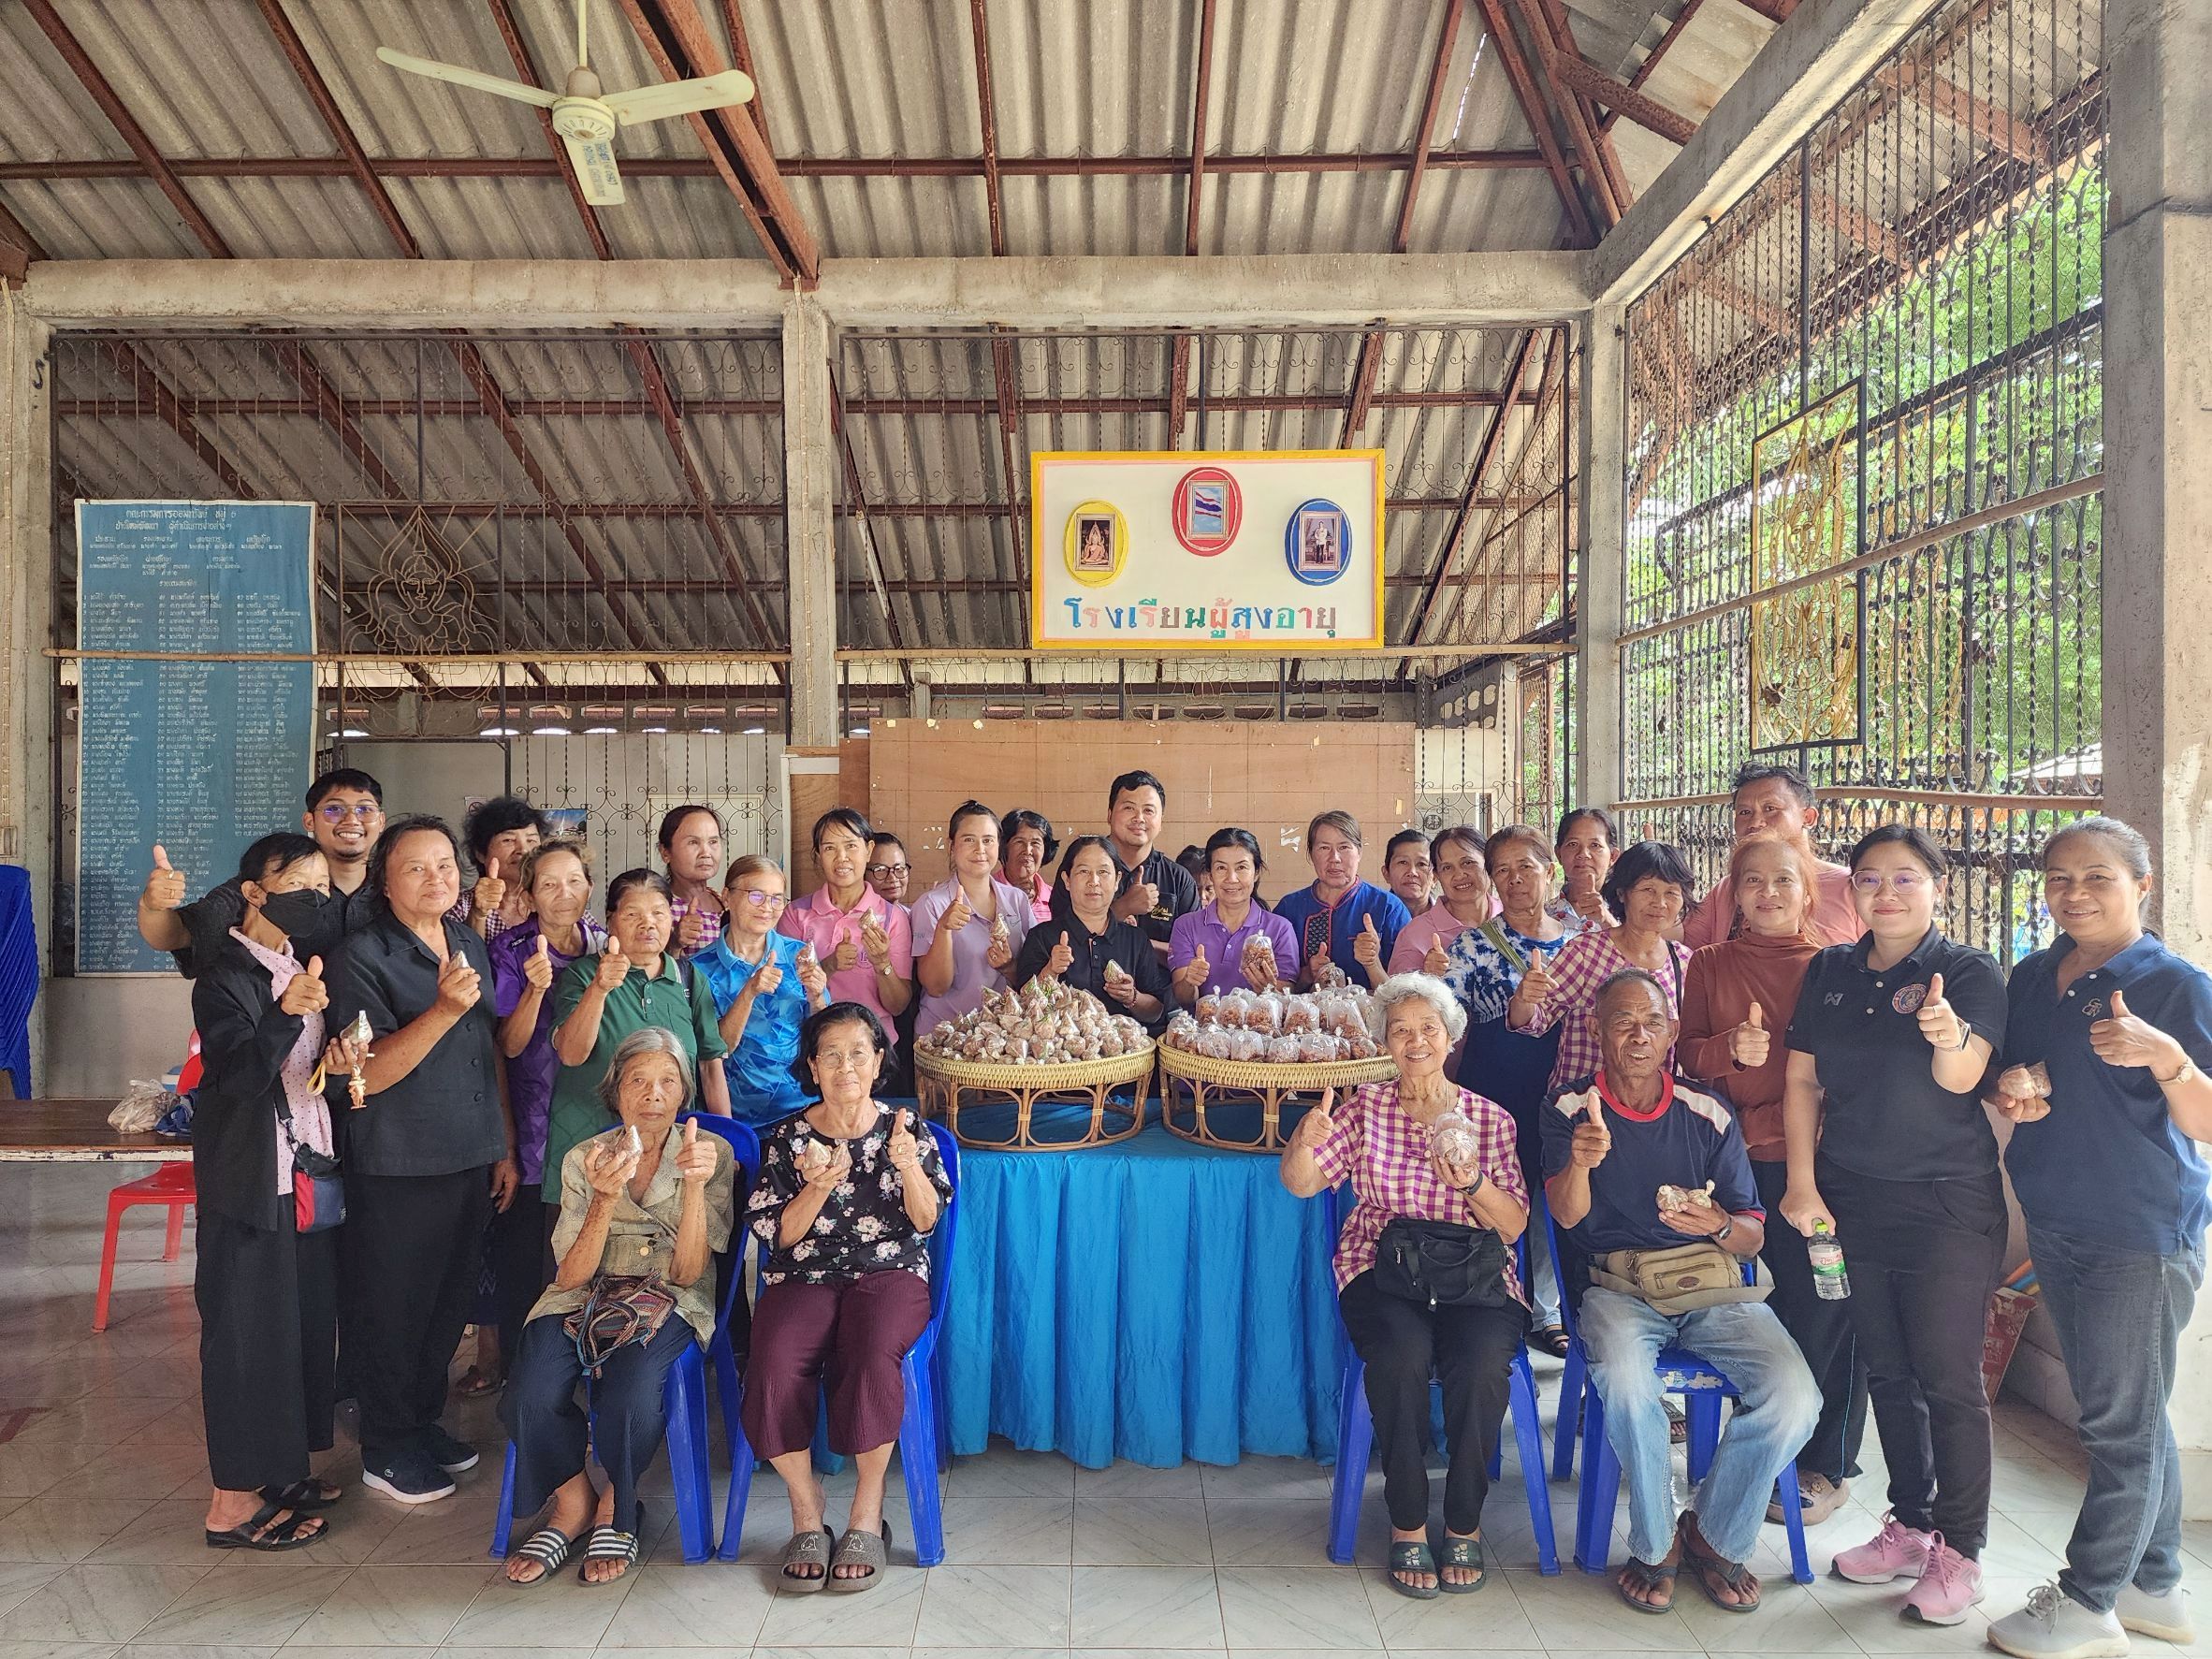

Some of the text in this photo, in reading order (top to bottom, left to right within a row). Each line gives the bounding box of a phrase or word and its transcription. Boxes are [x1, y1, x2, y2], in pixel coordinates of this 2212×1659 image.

[1063, 597, 1337, 639] โรงเรียนผู้สูงอายุ
